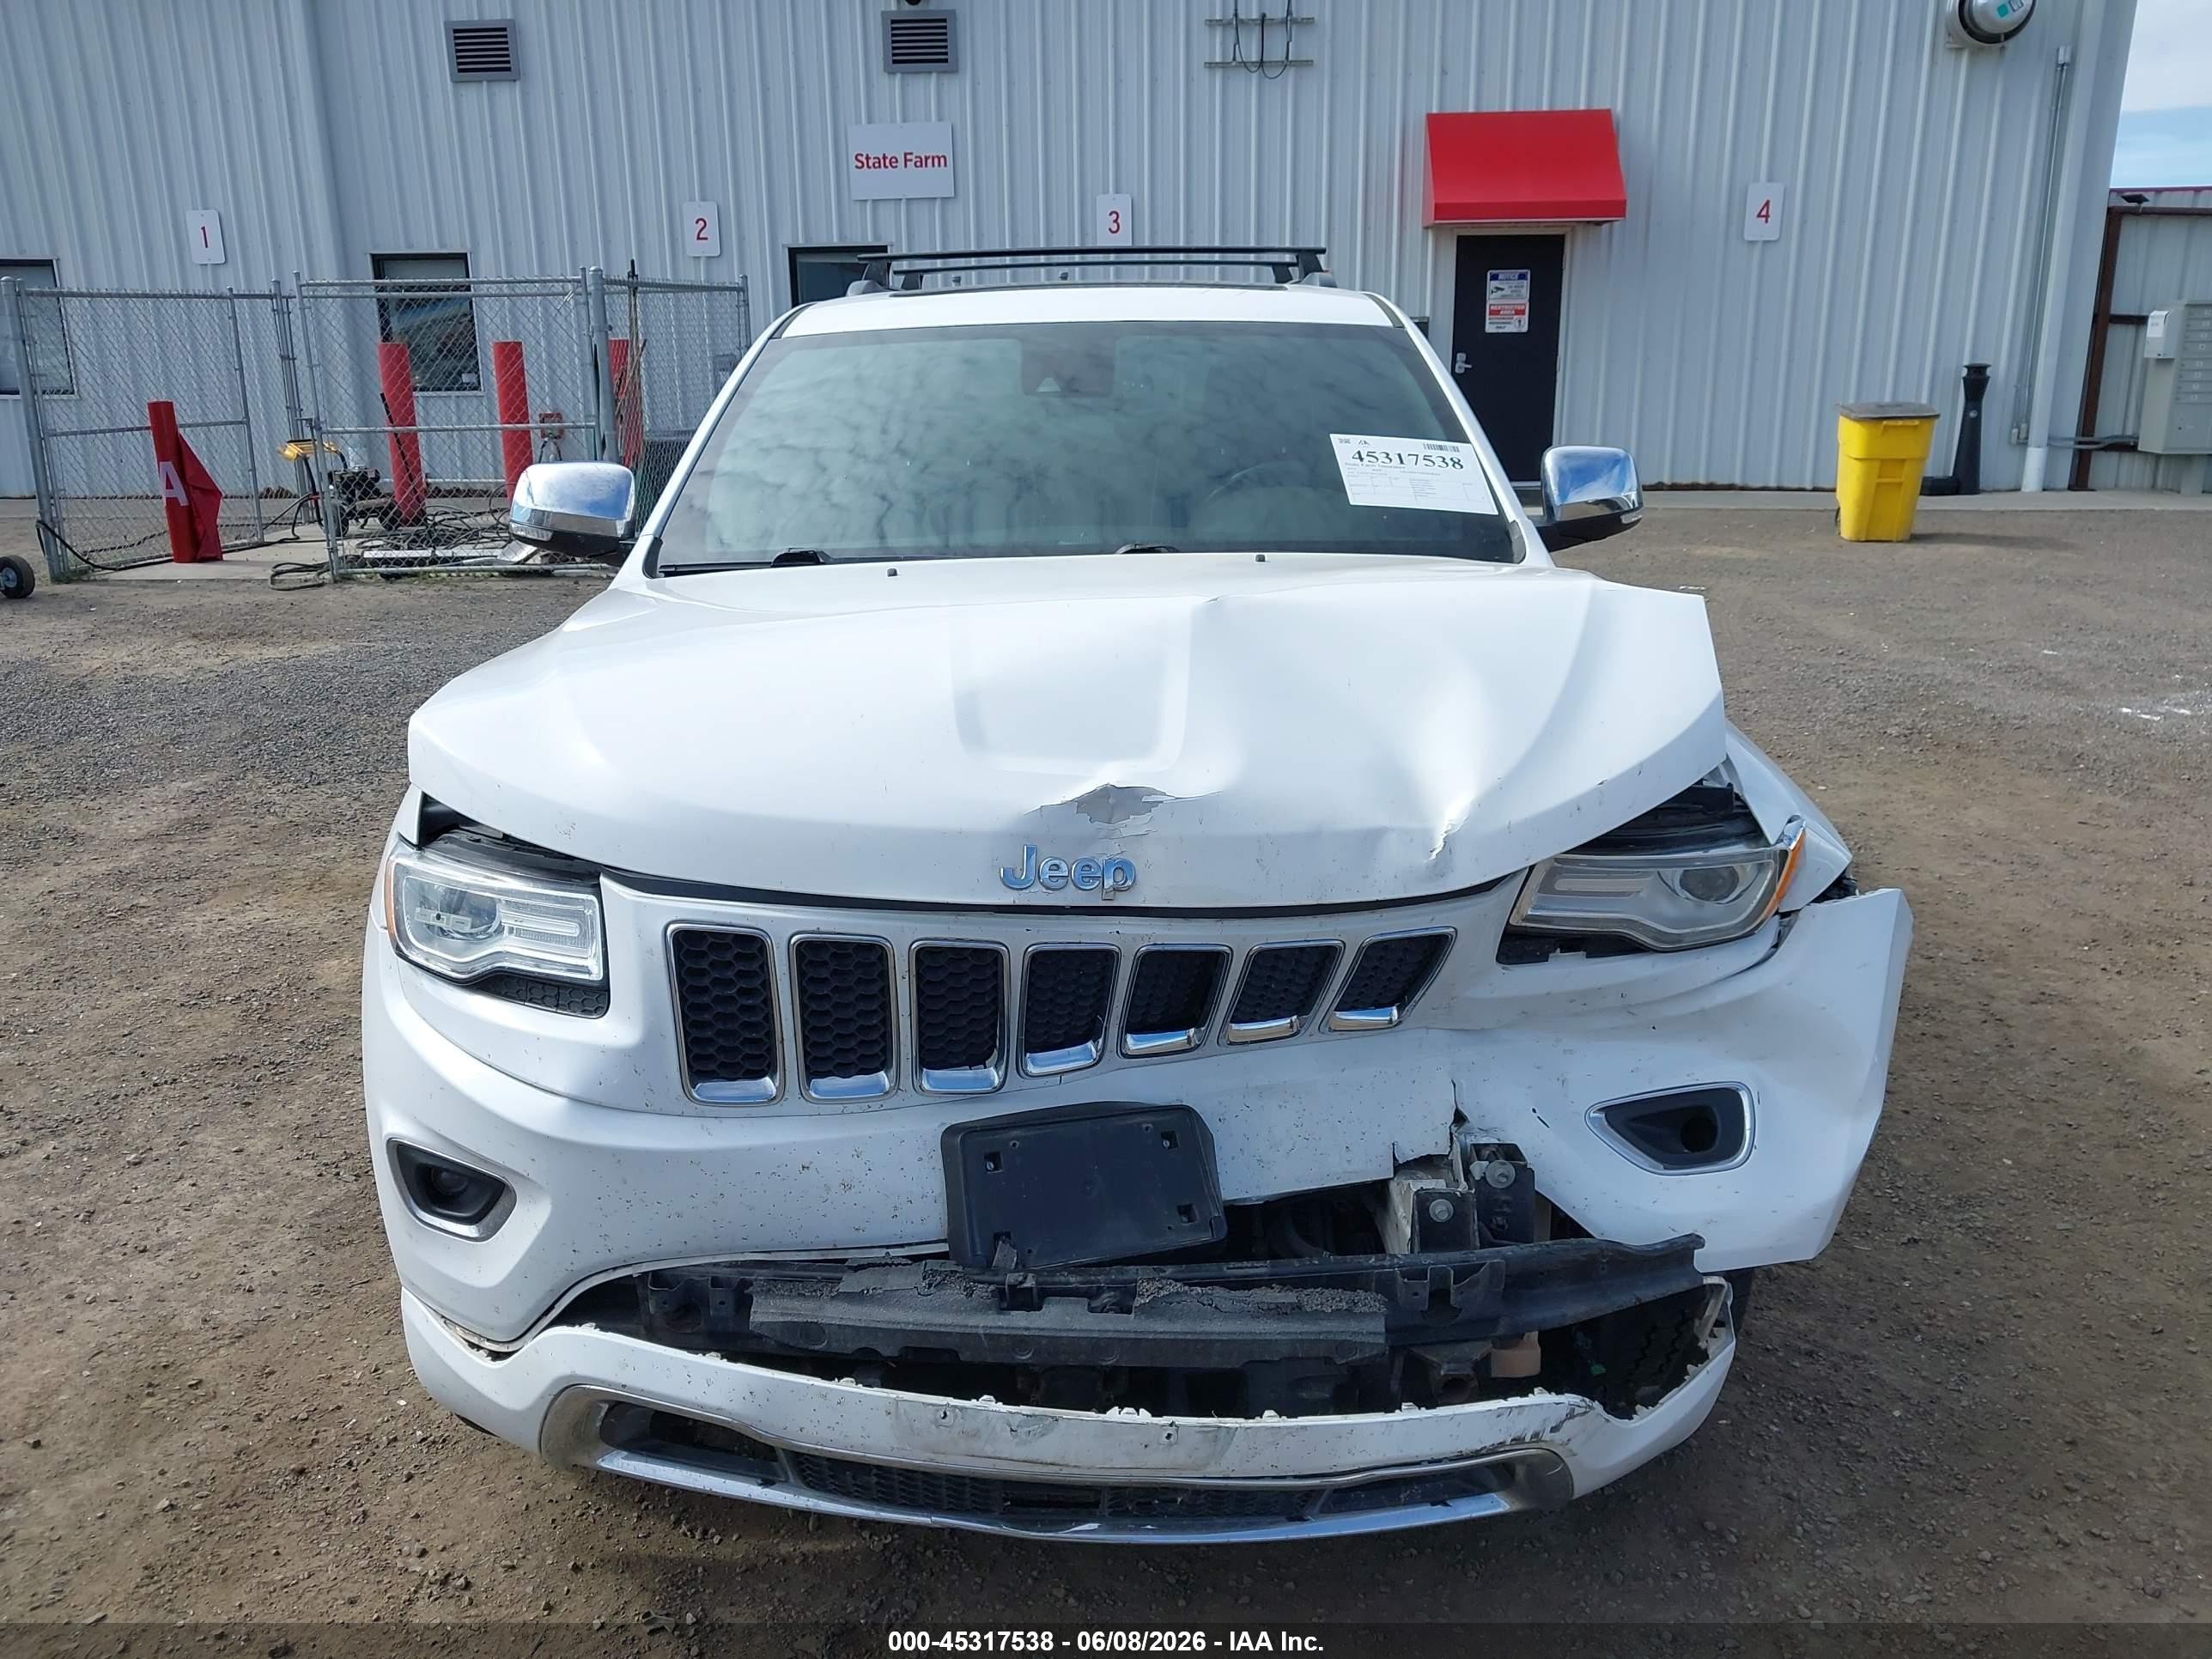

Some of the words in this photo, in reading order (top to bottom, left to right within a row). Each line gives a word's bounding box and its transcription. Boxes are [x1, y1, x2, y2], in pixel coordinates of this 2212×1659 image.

[854, 152, 899, 170] State
[903, 151, 948, 169] Farm
[1108, 210, 1121, 234] 3
[1756, 198, 1771, 224] 4
[200, 226, 209, 248] 1
[695, 217, 708, 241] 2
[1351, 449, 1465, 471] 45317538
[159, 461, 190, 507] A
[1000, 844, 1137, 902] Jeep
